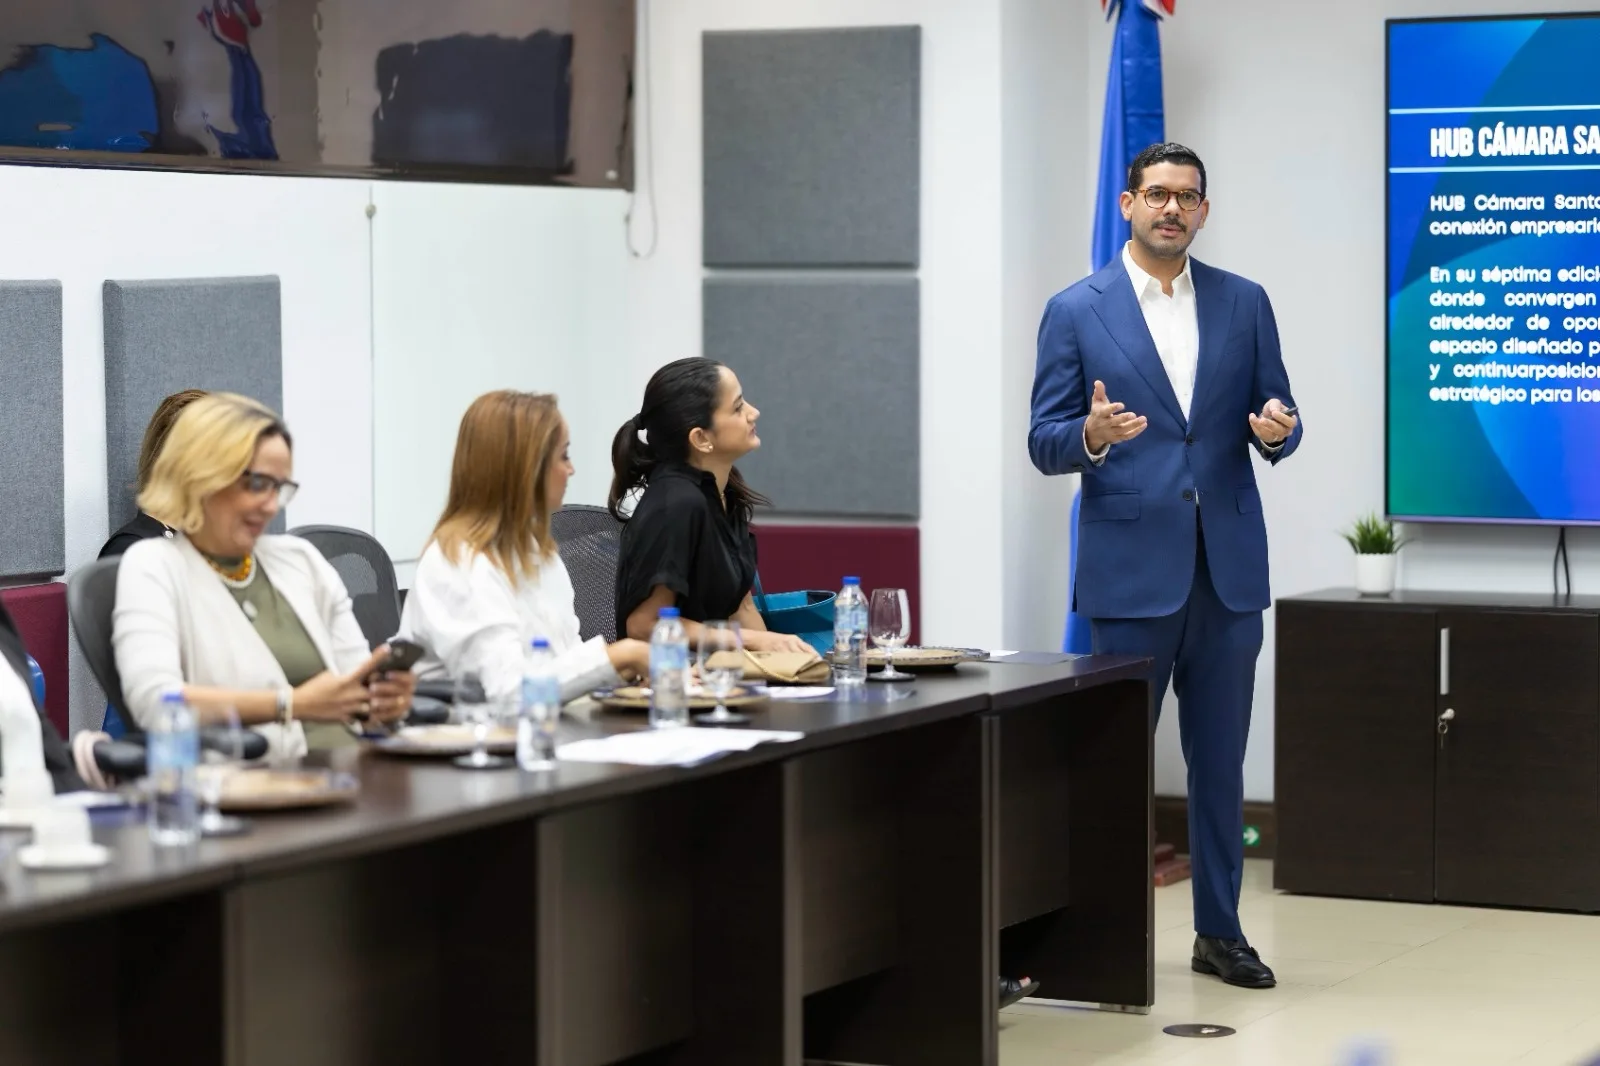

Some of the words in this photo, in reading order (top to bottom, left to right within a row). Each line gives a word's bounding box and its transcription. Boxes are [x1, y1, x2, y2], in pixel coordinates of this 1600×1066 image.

[1430, 128, 1474, 157] HUB
[1477, 122, 1569, 156] CÁMARA
[1573, 125, 1600, 154] SA
[1430, 195, 1466, 211] HUB
[1473, 194, 1545, 211] Cámara
[1429, 218, 1507, 235] conexión
[1509, 217, 1600, 237] empresari
[1430, 267, 1451, 282] En
[1455, 269, 1476, 282] su
[1481, 266, 1552, 285] séptima
[1557, 266, 1600, 282] edici
[1429, 290, 1486, 306] donde
[1504, 293, 1597, 309] convergen
[1429, 314, 1514, 330] alrededor
[1526, 314, 1550, 330] de
[1429, 338, 1498, 356] espacio
[1502, 337, 1584, 354] diseñado
[1429, 364, 1441, 380] y
[1429, 385, 1527, 405] estratégico
[1530, 389, 1573, 404] para
[1576, 386, 1600, 402] los
